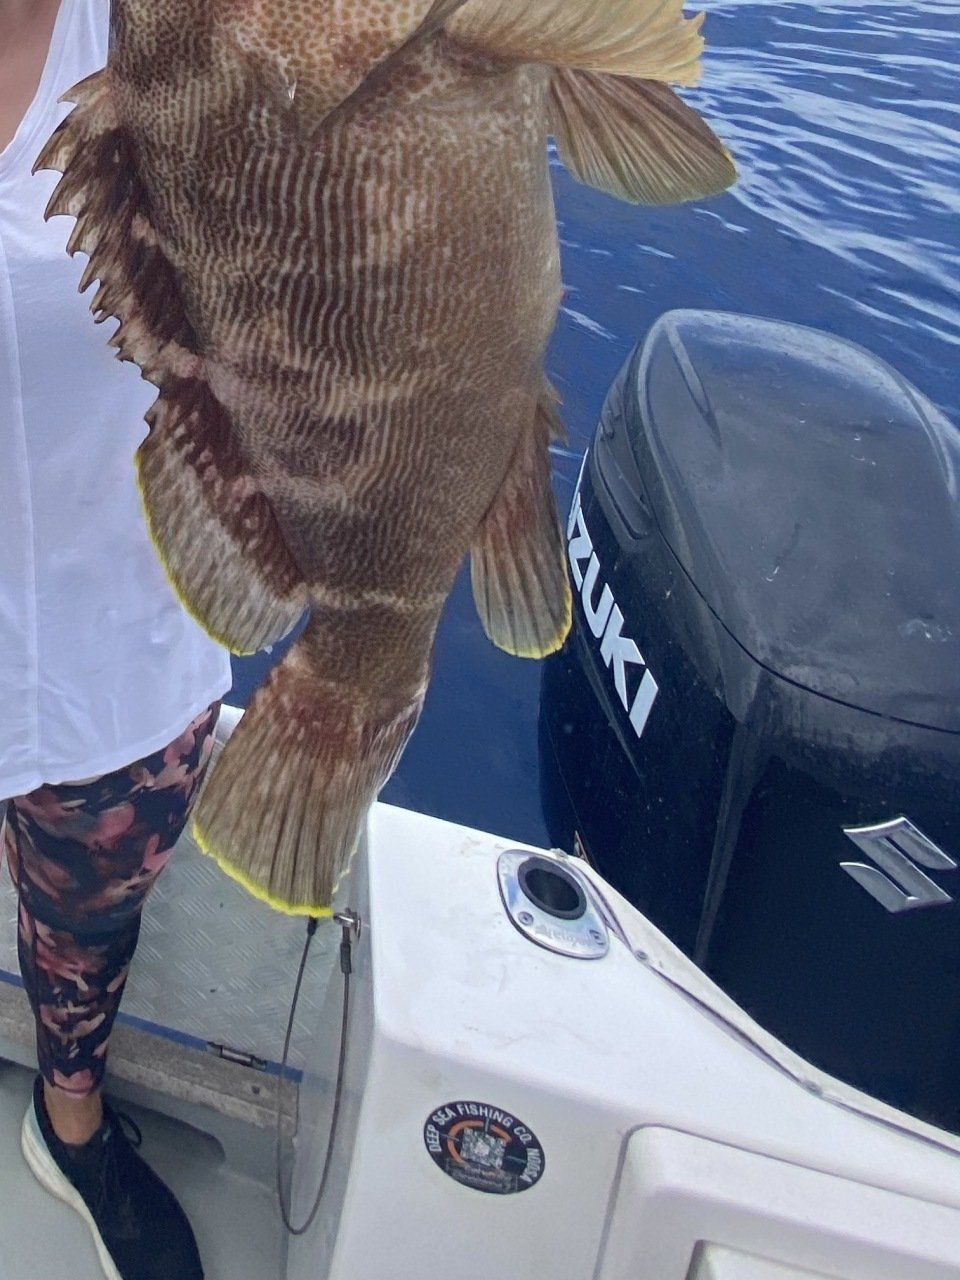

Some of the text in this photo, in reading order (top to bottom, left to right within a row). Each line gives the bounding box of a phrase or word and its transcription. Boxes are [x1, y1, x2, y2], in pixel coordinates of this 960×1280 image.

[566, 447, 659, 739] ZUKI
[432, 1107, 457, 1125] SEA
[456, 1103, 514, 1128] FISHING
[426, 1124, 442, 1152] DEEP
